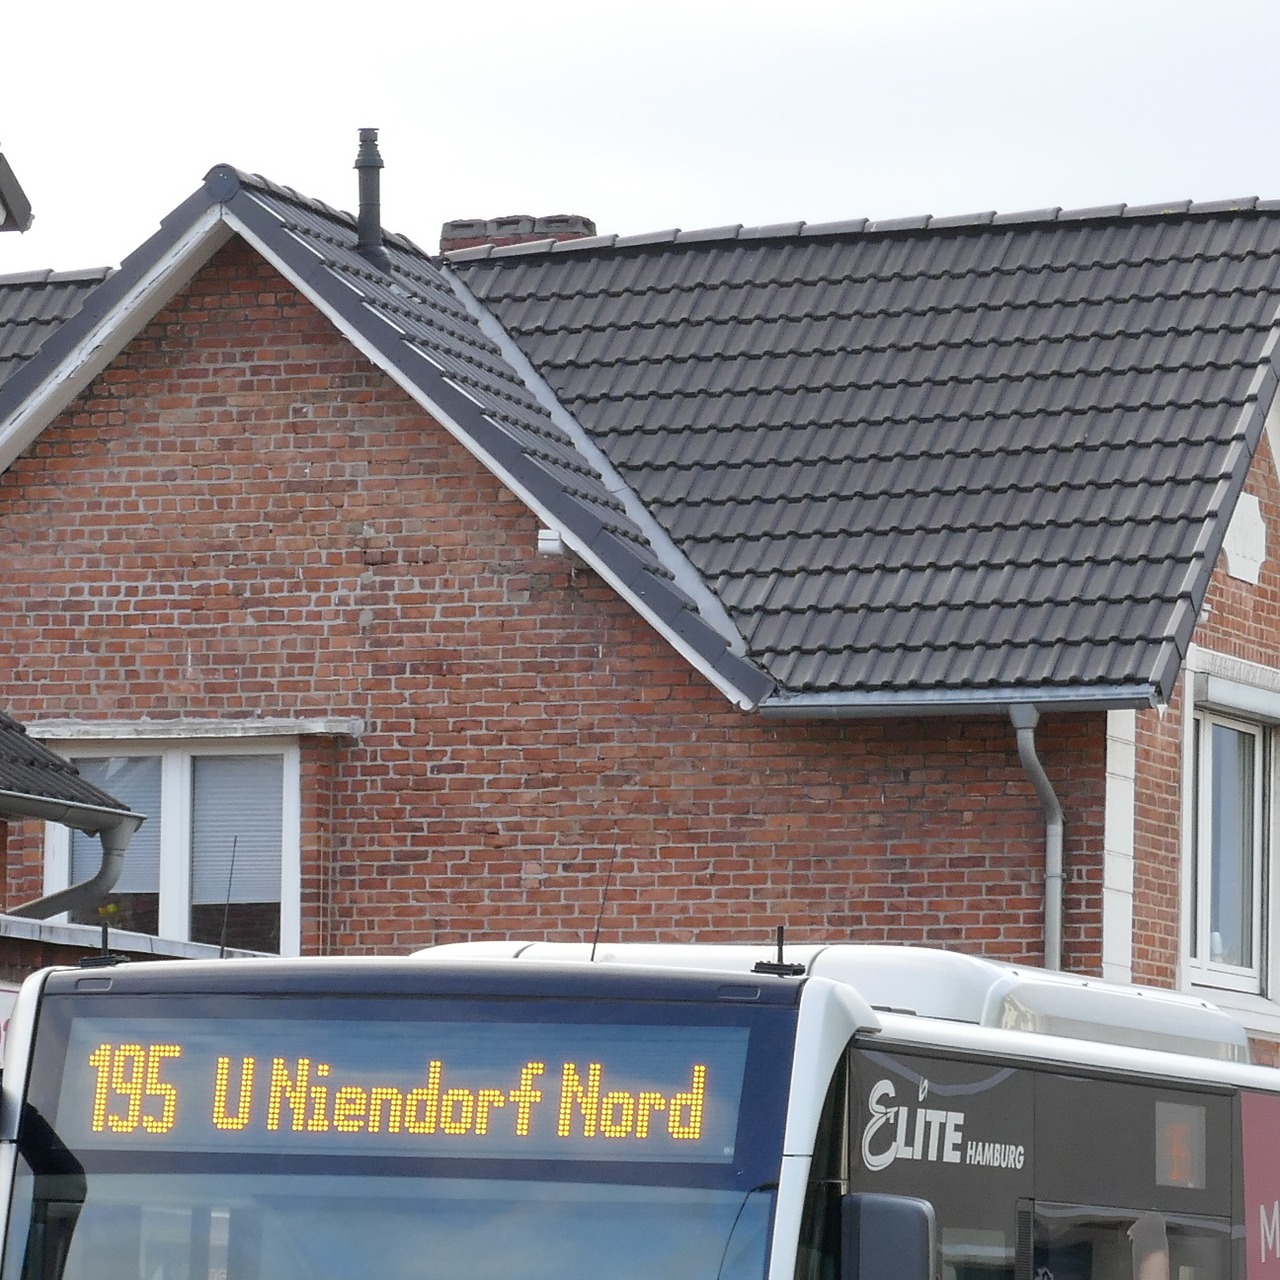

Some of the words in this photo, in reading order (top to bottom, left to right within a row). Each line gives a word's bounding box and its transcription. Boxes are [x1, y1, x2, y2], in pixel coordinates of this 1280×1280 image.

[89, 1043, 182, 1134] 195
[212, 1056, 256, 1130] U
[266, 1057, 546, 1137] Niendorf
[557, 1062, 707, 1140] Nord
[966, 1140, 1025, 1169] HAMBURG
